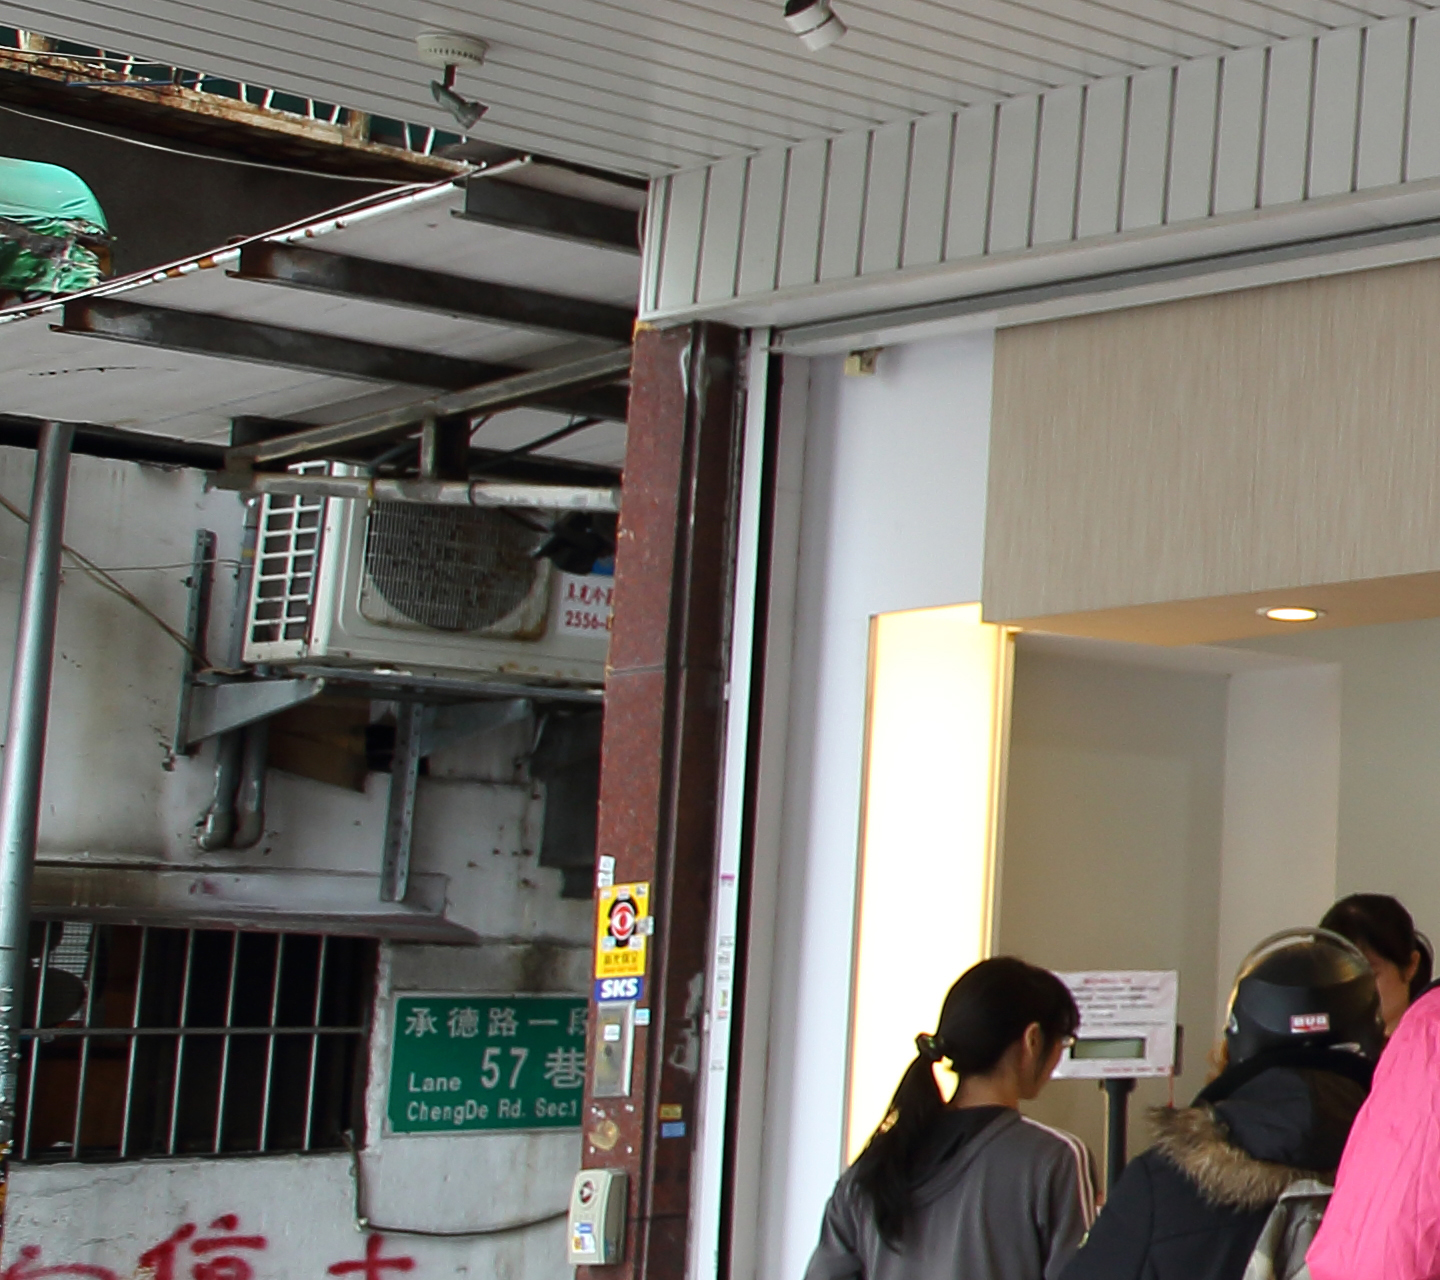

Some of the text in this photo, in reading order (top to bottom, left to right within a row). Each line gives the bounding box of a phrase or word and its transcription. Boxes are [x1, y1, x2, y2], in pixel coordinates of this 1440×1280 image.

[565, 610, 610, 630] 2556-
[601, 978, 639, 999] SKS
[408, 1073, 461, 1093] Lane
[407, 1099, 489, 1125] ChengDe
[498, 1098, 526, 1118] Rd.
